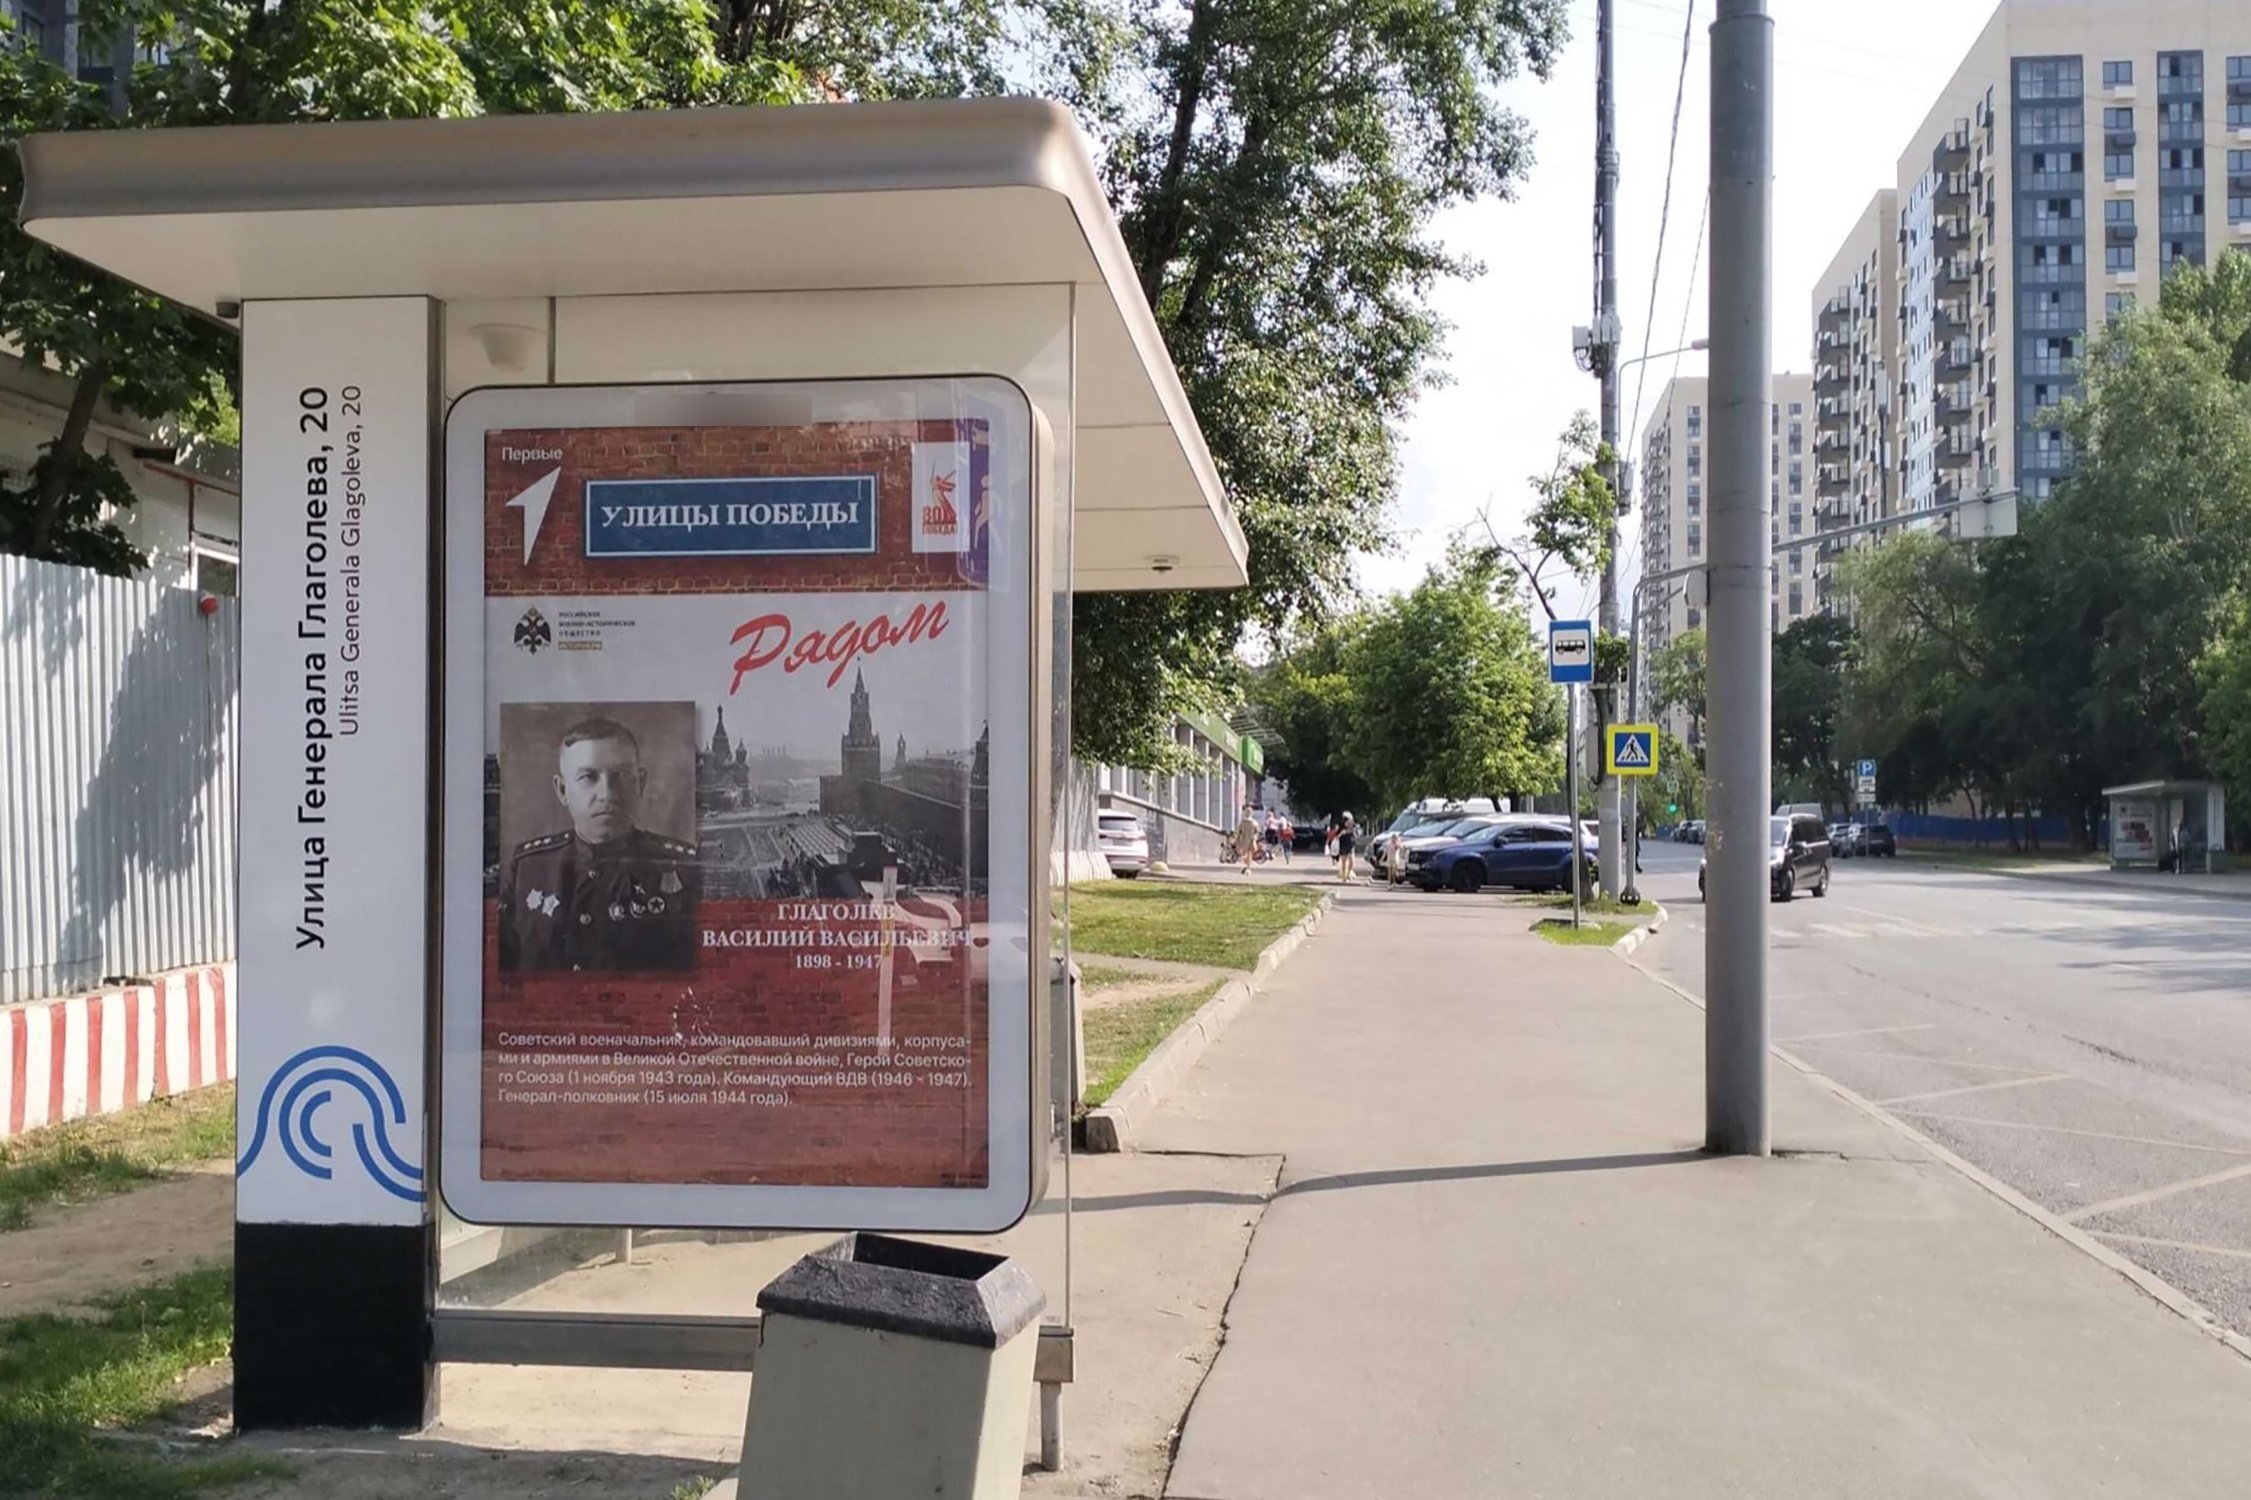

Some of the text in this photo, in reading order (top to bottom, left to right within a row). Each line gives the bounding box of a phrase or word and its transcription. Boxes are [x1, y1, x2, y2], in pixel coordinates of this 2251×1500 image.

[501, 446, 563, 465] Первые
[602, 502, 860, 532] УЛИЦЫ ПОБЕДЫ
[339, 385, 366, 736] Ulitsa Generala Glagoleva, 20
[729, 600, 950, 695] Рядом
[296, 386, 334, 949] Улица Генерала Глаголева, 20
[777, 903, 896, 921] ГЛАГОЛЕВ
[702, 925, 972, 949] ВАСИЛИЙ ВАСИЛЬЕВИЧ
[796, 954, 832, 969] 1898
[847, 954, 883, 969] 1947
[498, 1032, 972, 1050] Советский военачальник, командовавший дивизиями, корпуса-
[498, 1051, 972, 1068] ми и армиями в Великой Отечественной войне, Герой Советско-
[499, 1073, 513, 1084] го
[516, 1070, 564, 1084] Союза
[568, 1070, 579, 1086] (1
[583, 1069, 635, 1087] ноября
[639, 1071, 674, 1084] 1943
[724, 1070, 833, 1088] Командующий
[836, 1073, 867, 1087] ВДВ
[871, 1072, 913, 1087] (1946
[928, 1073, 972, 1088] 1947).
[499, 1089, 793, 1106] Генерал-полковник (15 июля 1944 года).
